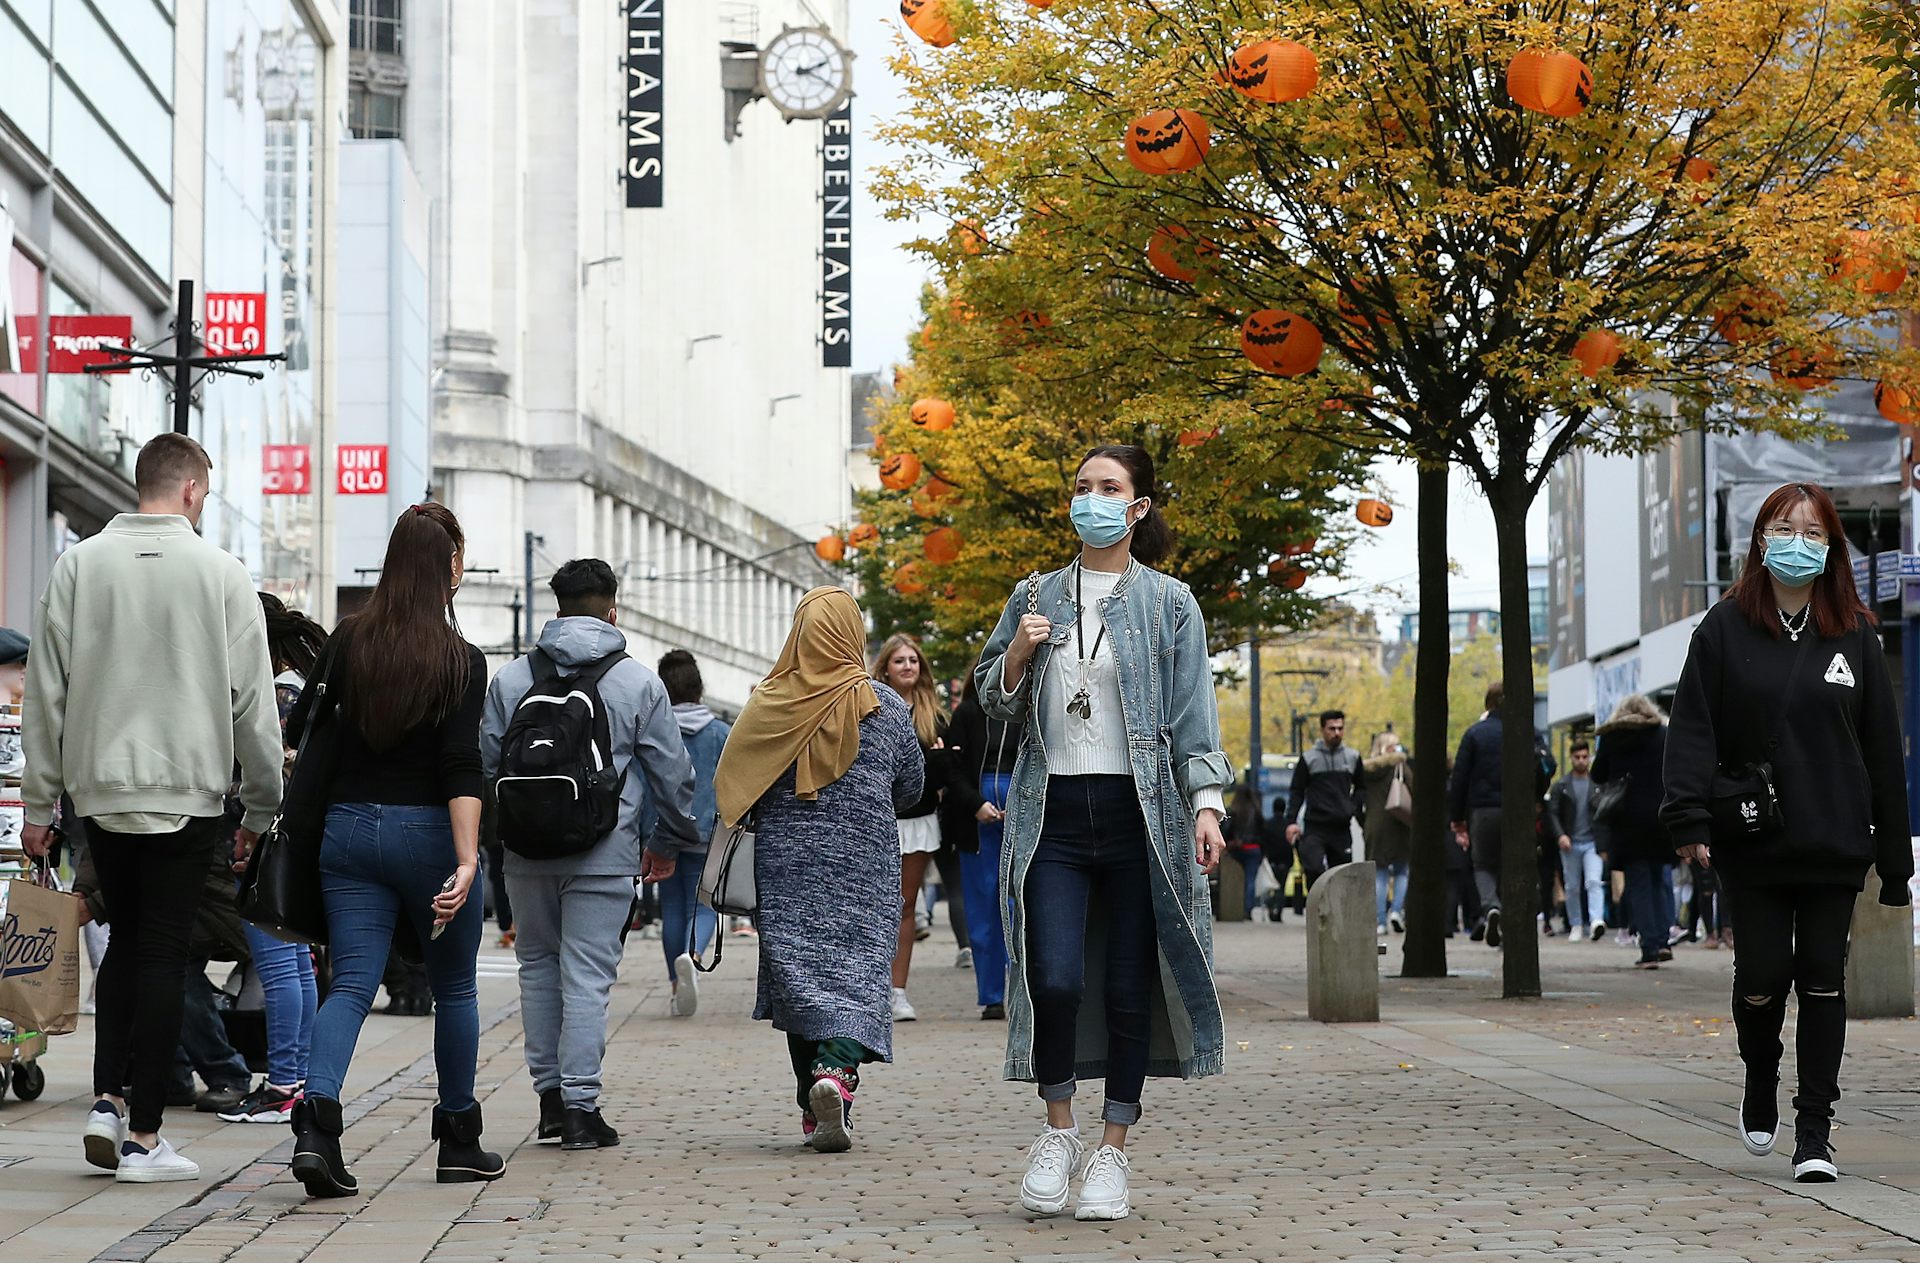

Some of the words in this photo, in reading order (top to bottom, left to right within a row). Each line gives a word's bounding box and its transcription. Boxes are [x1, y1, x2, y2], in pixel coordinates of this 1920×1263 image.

[824, 98, 850, 346] EBENHAMS
[207, 299, 256, 324] UNI
[207, 326, 260, 355] QLO
[342, 450, 381, 469] UNI
[341, 470, 383, 493] QLO
